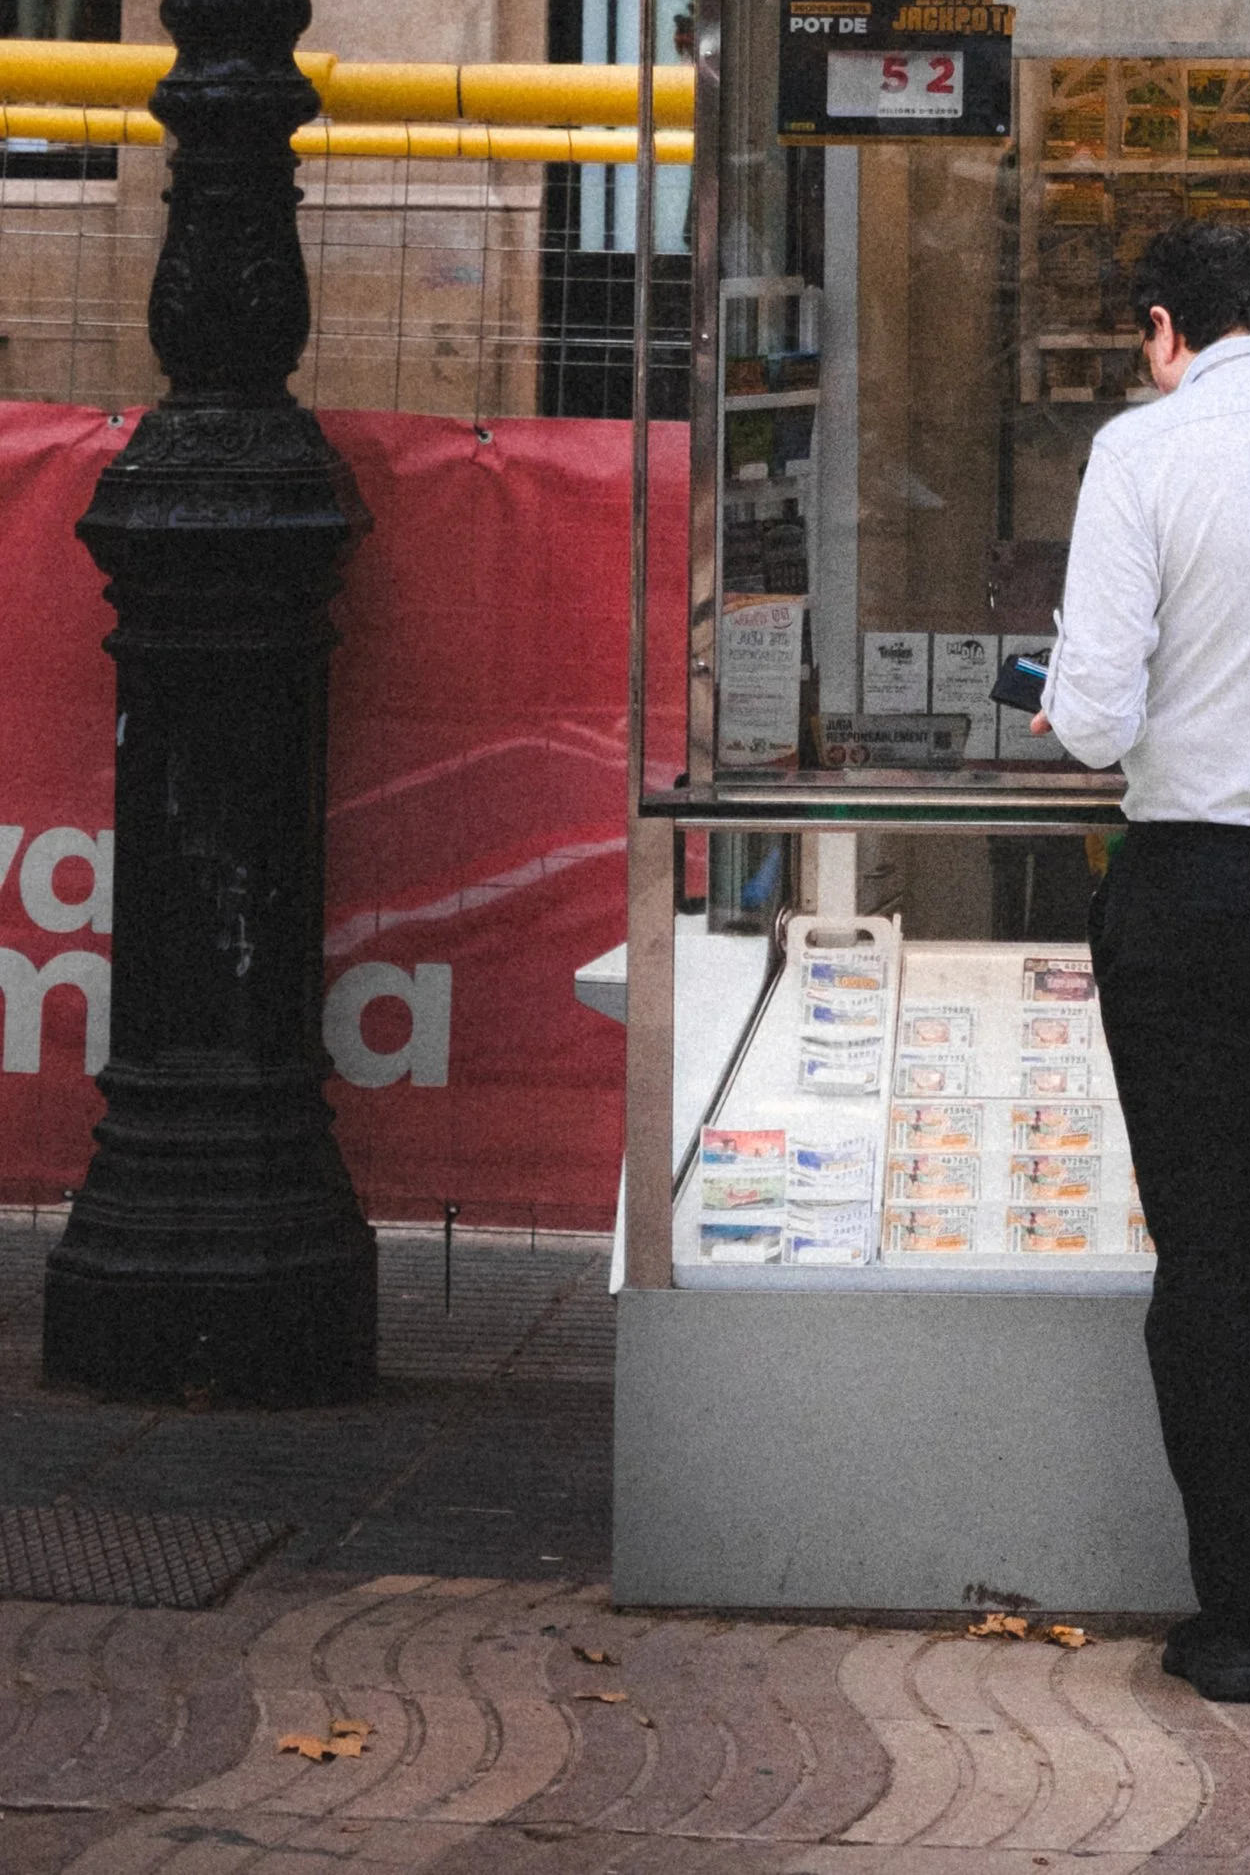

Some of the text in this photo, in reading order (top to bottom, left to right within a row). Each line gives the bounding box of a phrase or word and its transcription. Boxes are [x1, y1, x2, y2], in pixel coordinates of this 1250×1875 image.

[790, 17, 867, 34] POT DE
[892, 5, 1004, 33] JACKPOT
[826, 720, 853, 731] JUGA
[826, 731, 929, 743] RESPONSABLEMENT
